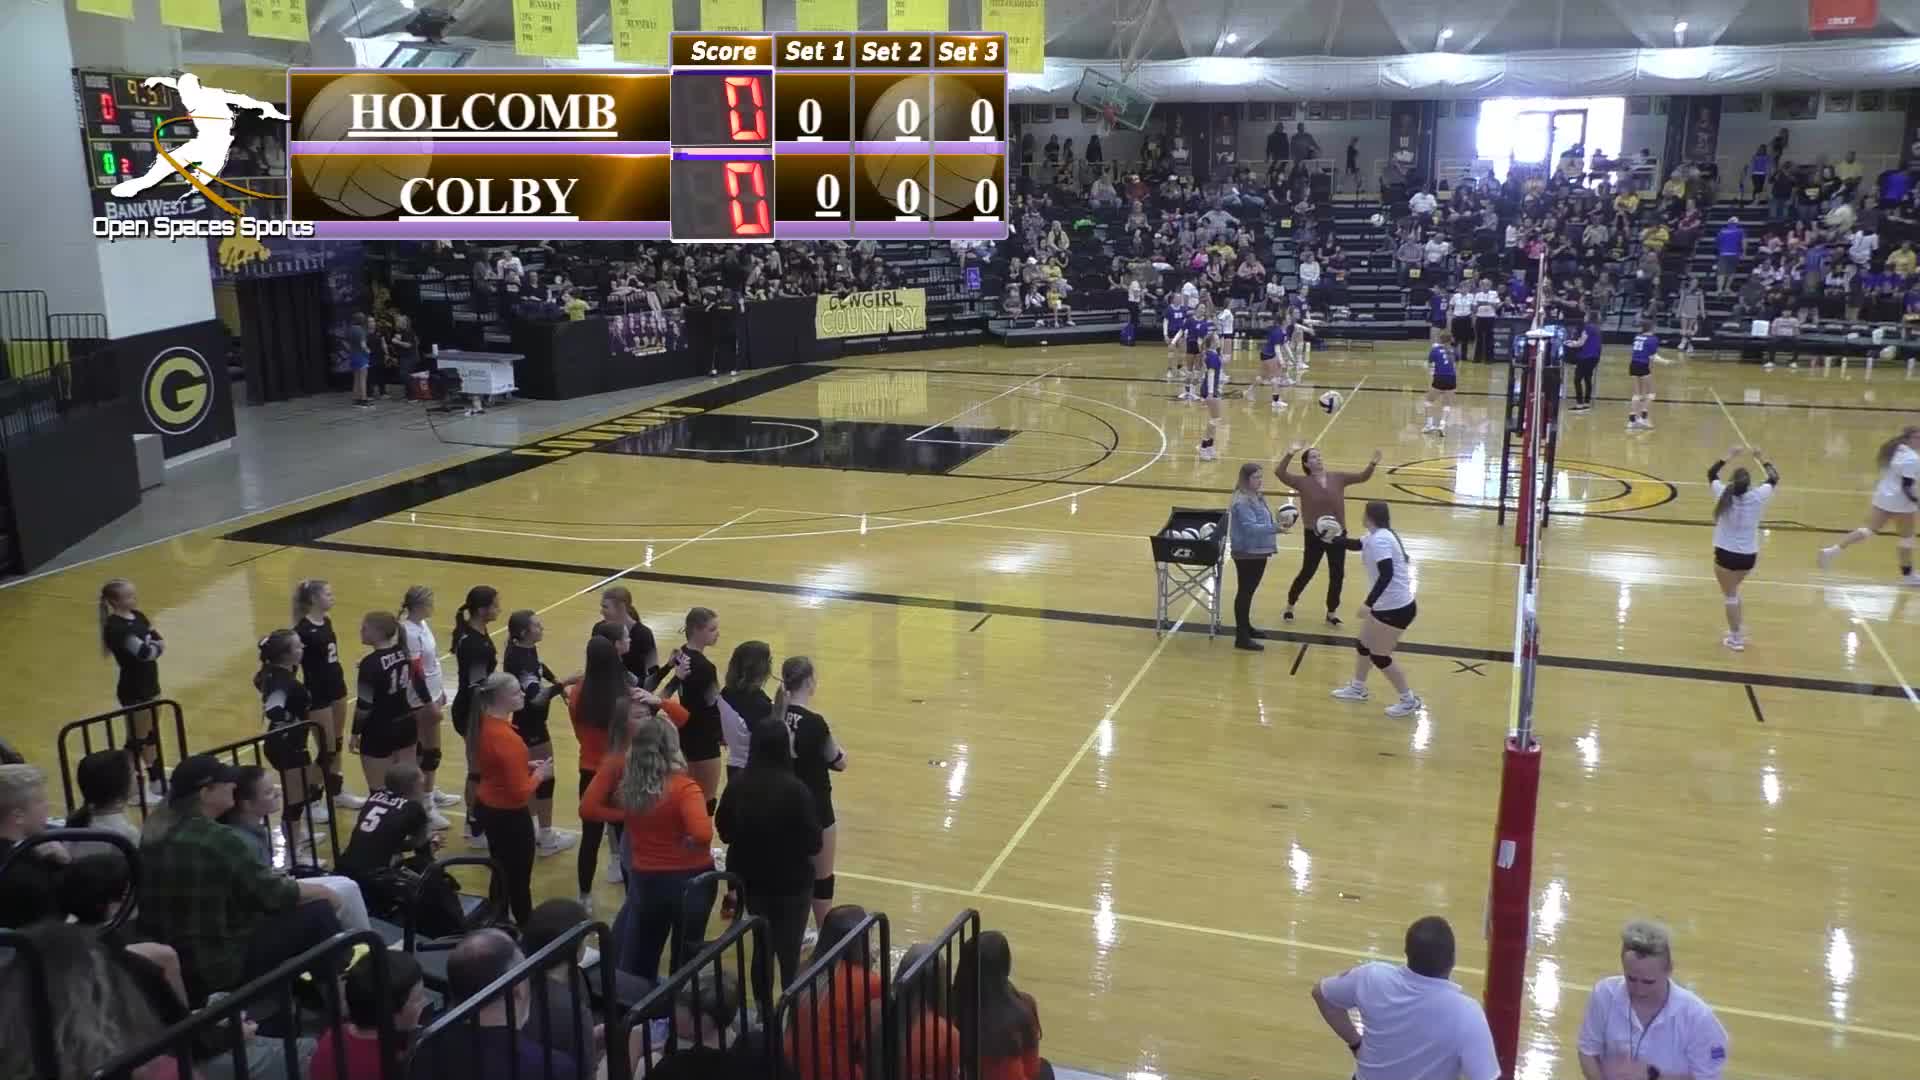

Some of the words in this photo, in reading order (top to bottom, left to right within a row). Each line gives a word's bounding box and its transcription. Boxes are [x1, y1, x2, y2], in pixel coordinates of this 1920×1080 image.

[101, 93, 114, 119] 0
[103, 152, 116, 174] 0
[822, 305, 920, 334] COUNTRY
[150, 356, 207, 424] G
[327, 642, 337, 664] 2
[380, 649, 405, 671] COLB
[360, 805, 388, 833] 5
